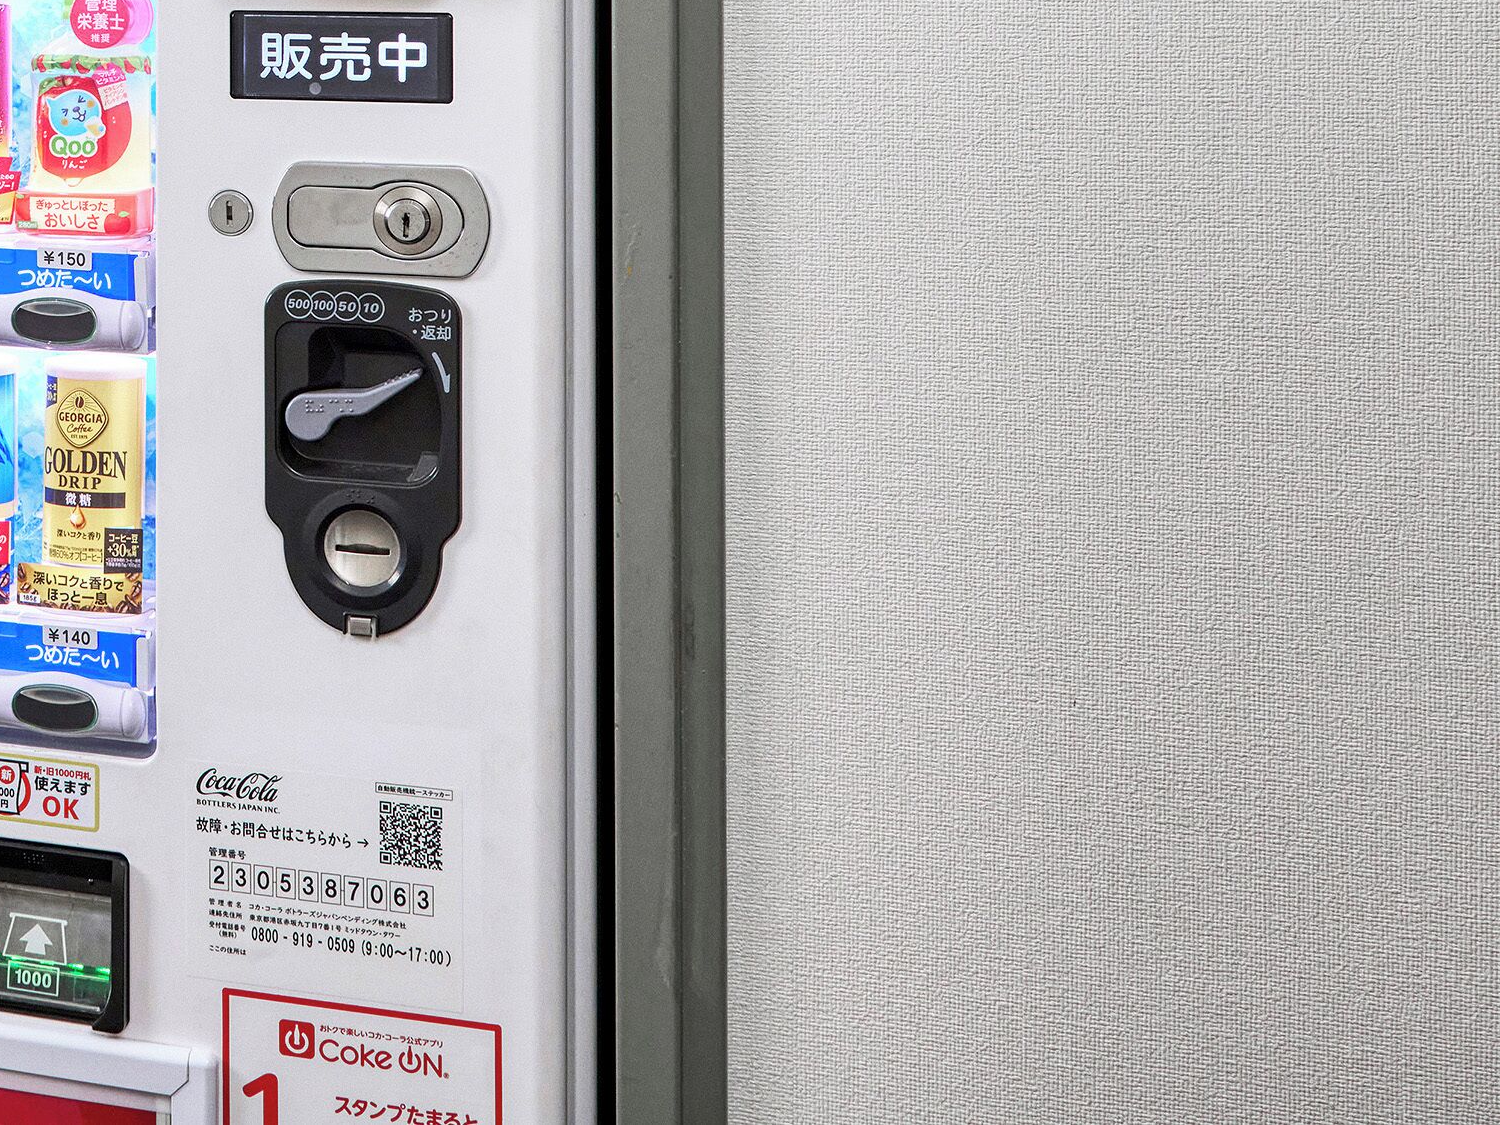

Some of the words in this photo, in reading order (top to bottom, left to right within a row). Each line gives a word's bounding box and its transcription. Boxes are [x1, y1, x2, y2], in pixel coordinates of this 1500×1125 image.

[78, 13, 124, 30] 栄養士
[260, 32, 428, 83] 販売中
[51, 136, 96, 155] Qoo
[62, 160, 87, 169] りんご
[36, 200, 108, 212] ぎゅっとしぼった
[45, 213, 100, 229] おいしさ
[43, 251, 86, 266] ¥150
[288, 298, 309, 309] 500
[313, 300, 334, 311] 100
[338, 302, 356, 313] 50
[363, 303, 379, 313] 10
[408, 307, 451, 323] おつり
[59, 412, 103, 423] GEORGIA
[45, 446, 127, 480] GOLDEN
[58, 475, 102, 489] DRIP
[66, 493, 91, 506] 微糖
[33, 571, 124, 591] 深いコクと香りで
[47, 588, 108, 605] ほっと一息
[48, 629, 91, 644] ¥140
[35, 776, 91, 795] 使えます
[196, 767, 284, 803] Coca-Cola
[1, 799, 8, 808] 円
[43, 796, 79, 820] OK
[196, 799, 236, 809] BOTTLERS
[238, 803, 262, 812] JAPAN
[264, 806, 280, 814] INC.
[209, 847, 246, 859] 管理番号
[209, 946, 246, 955] ここの住所は
[14, 969, 52, 989] 1000
[319, 1039, 392, 1070] Coke
